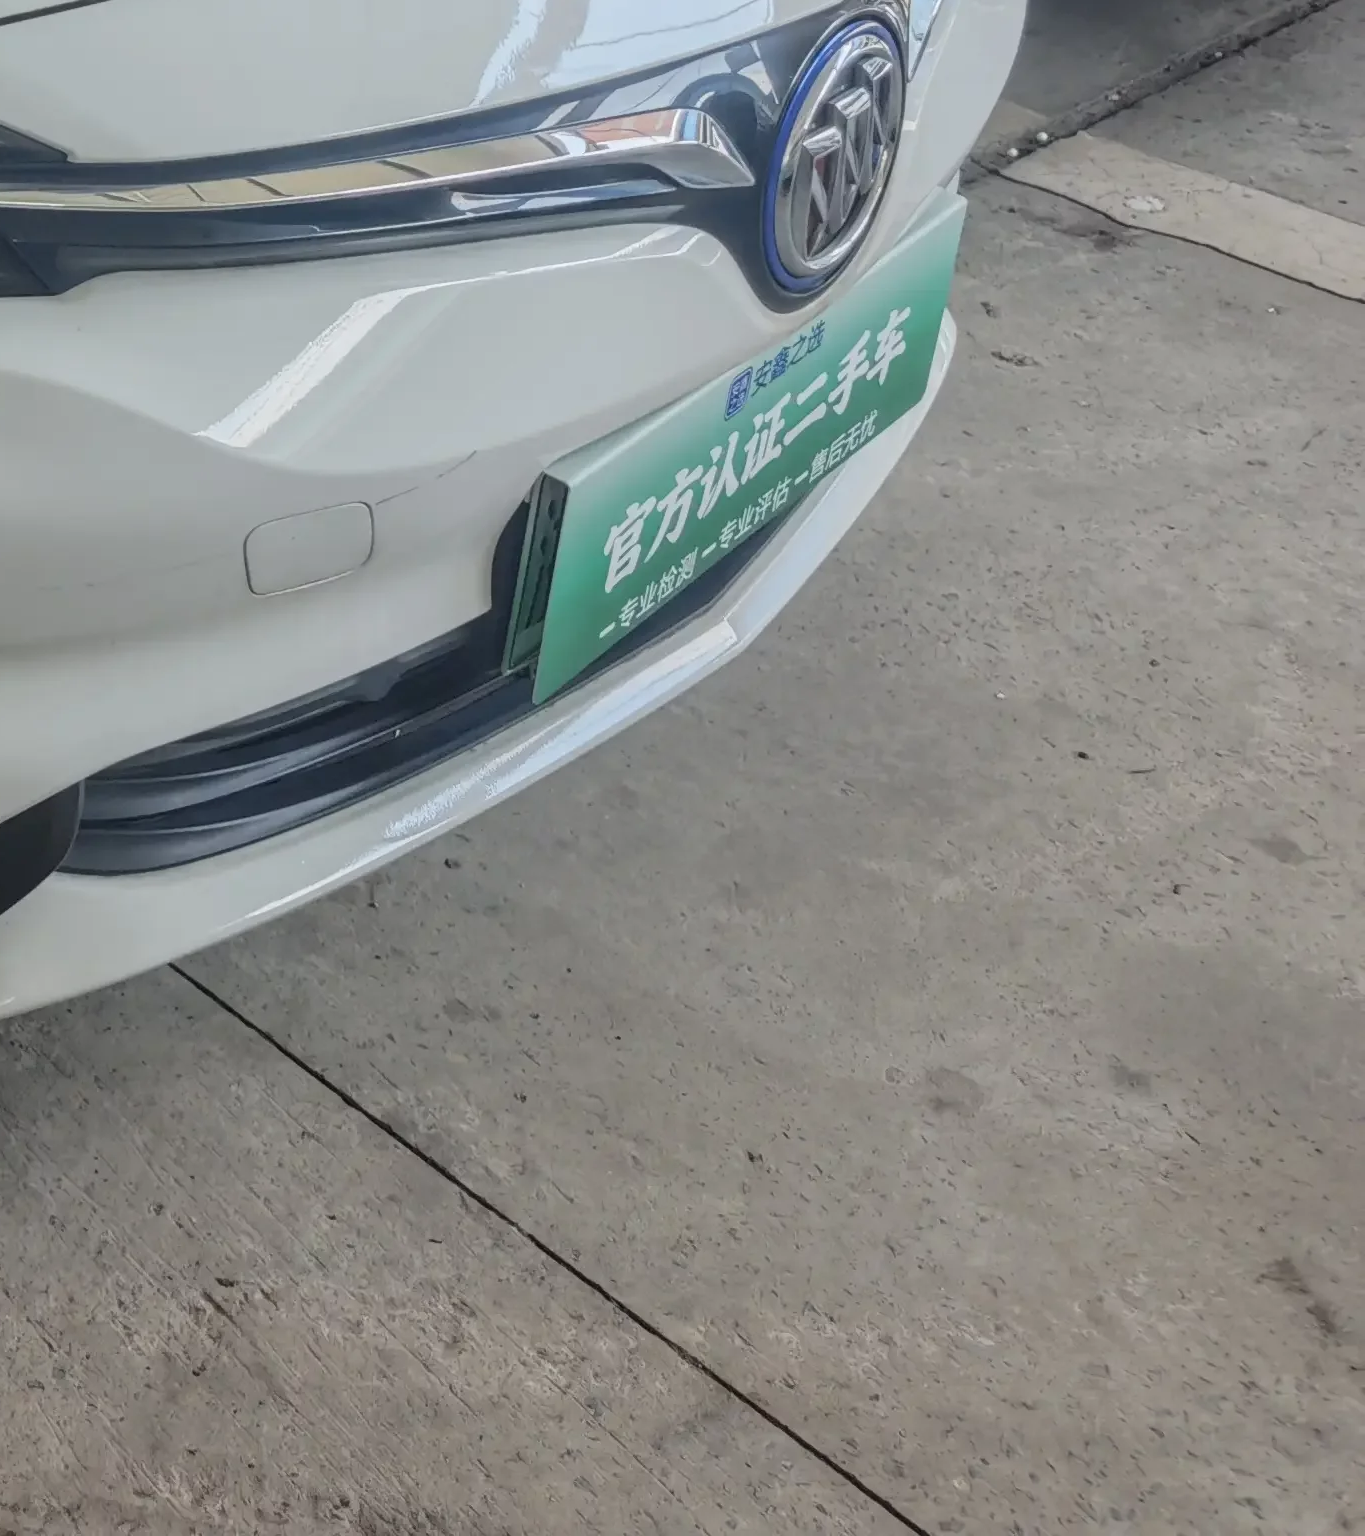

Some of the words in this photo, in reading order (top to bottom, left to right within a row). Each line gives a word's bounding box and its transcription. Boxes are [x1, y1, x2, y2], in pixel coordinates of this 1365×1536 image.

[751, 319, 825, 396] 安鑫之选
[603, 306, 911, 594] 官方认证二手车
